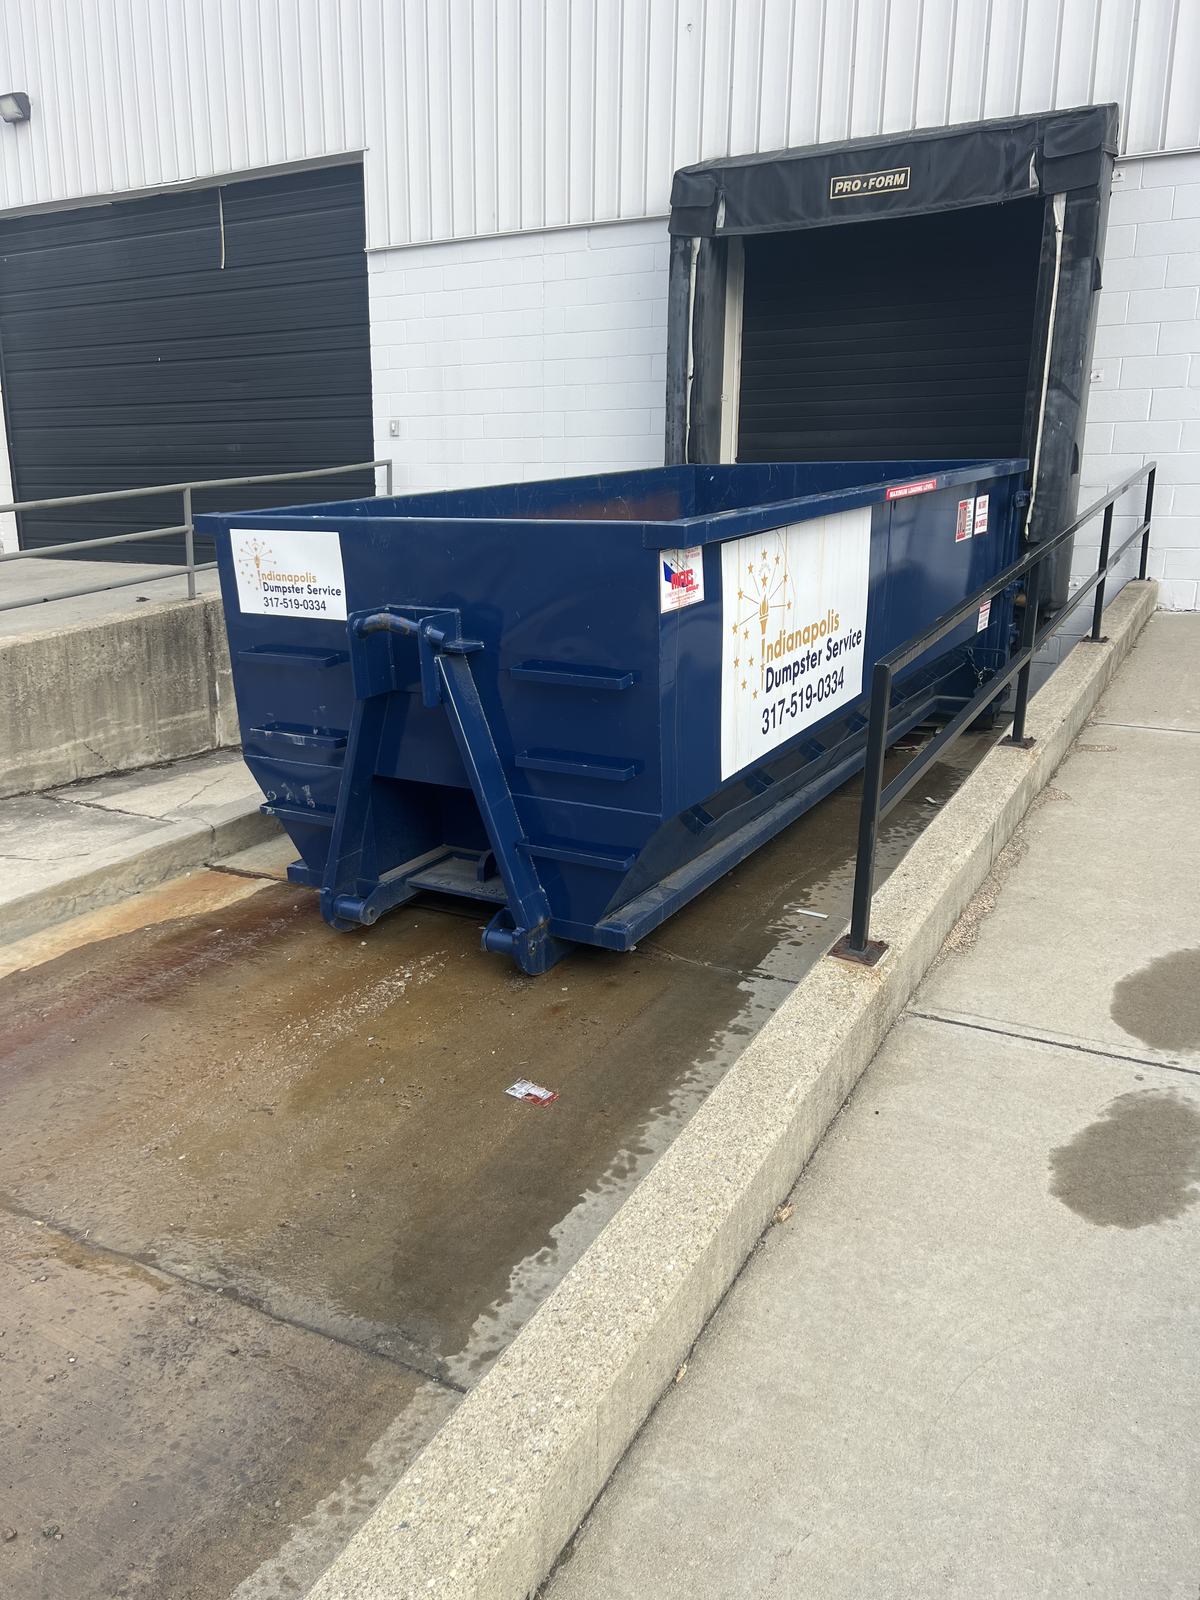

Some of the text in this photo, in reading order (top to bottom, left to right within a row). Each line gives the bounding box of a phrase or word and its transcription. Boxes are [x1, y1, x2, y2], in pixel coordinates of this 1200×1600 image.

[257, 570, 317, 585] Indianapolis
[263, 582, 342, 596] Dumpster Service
[263, 597, 327, 611] 317-519-0334
[761, 609, 840, 663] Indianapolis
[765, 628, 862, 693] Dumpster Service
[761, 666, 845, 735] 317-519-0334
